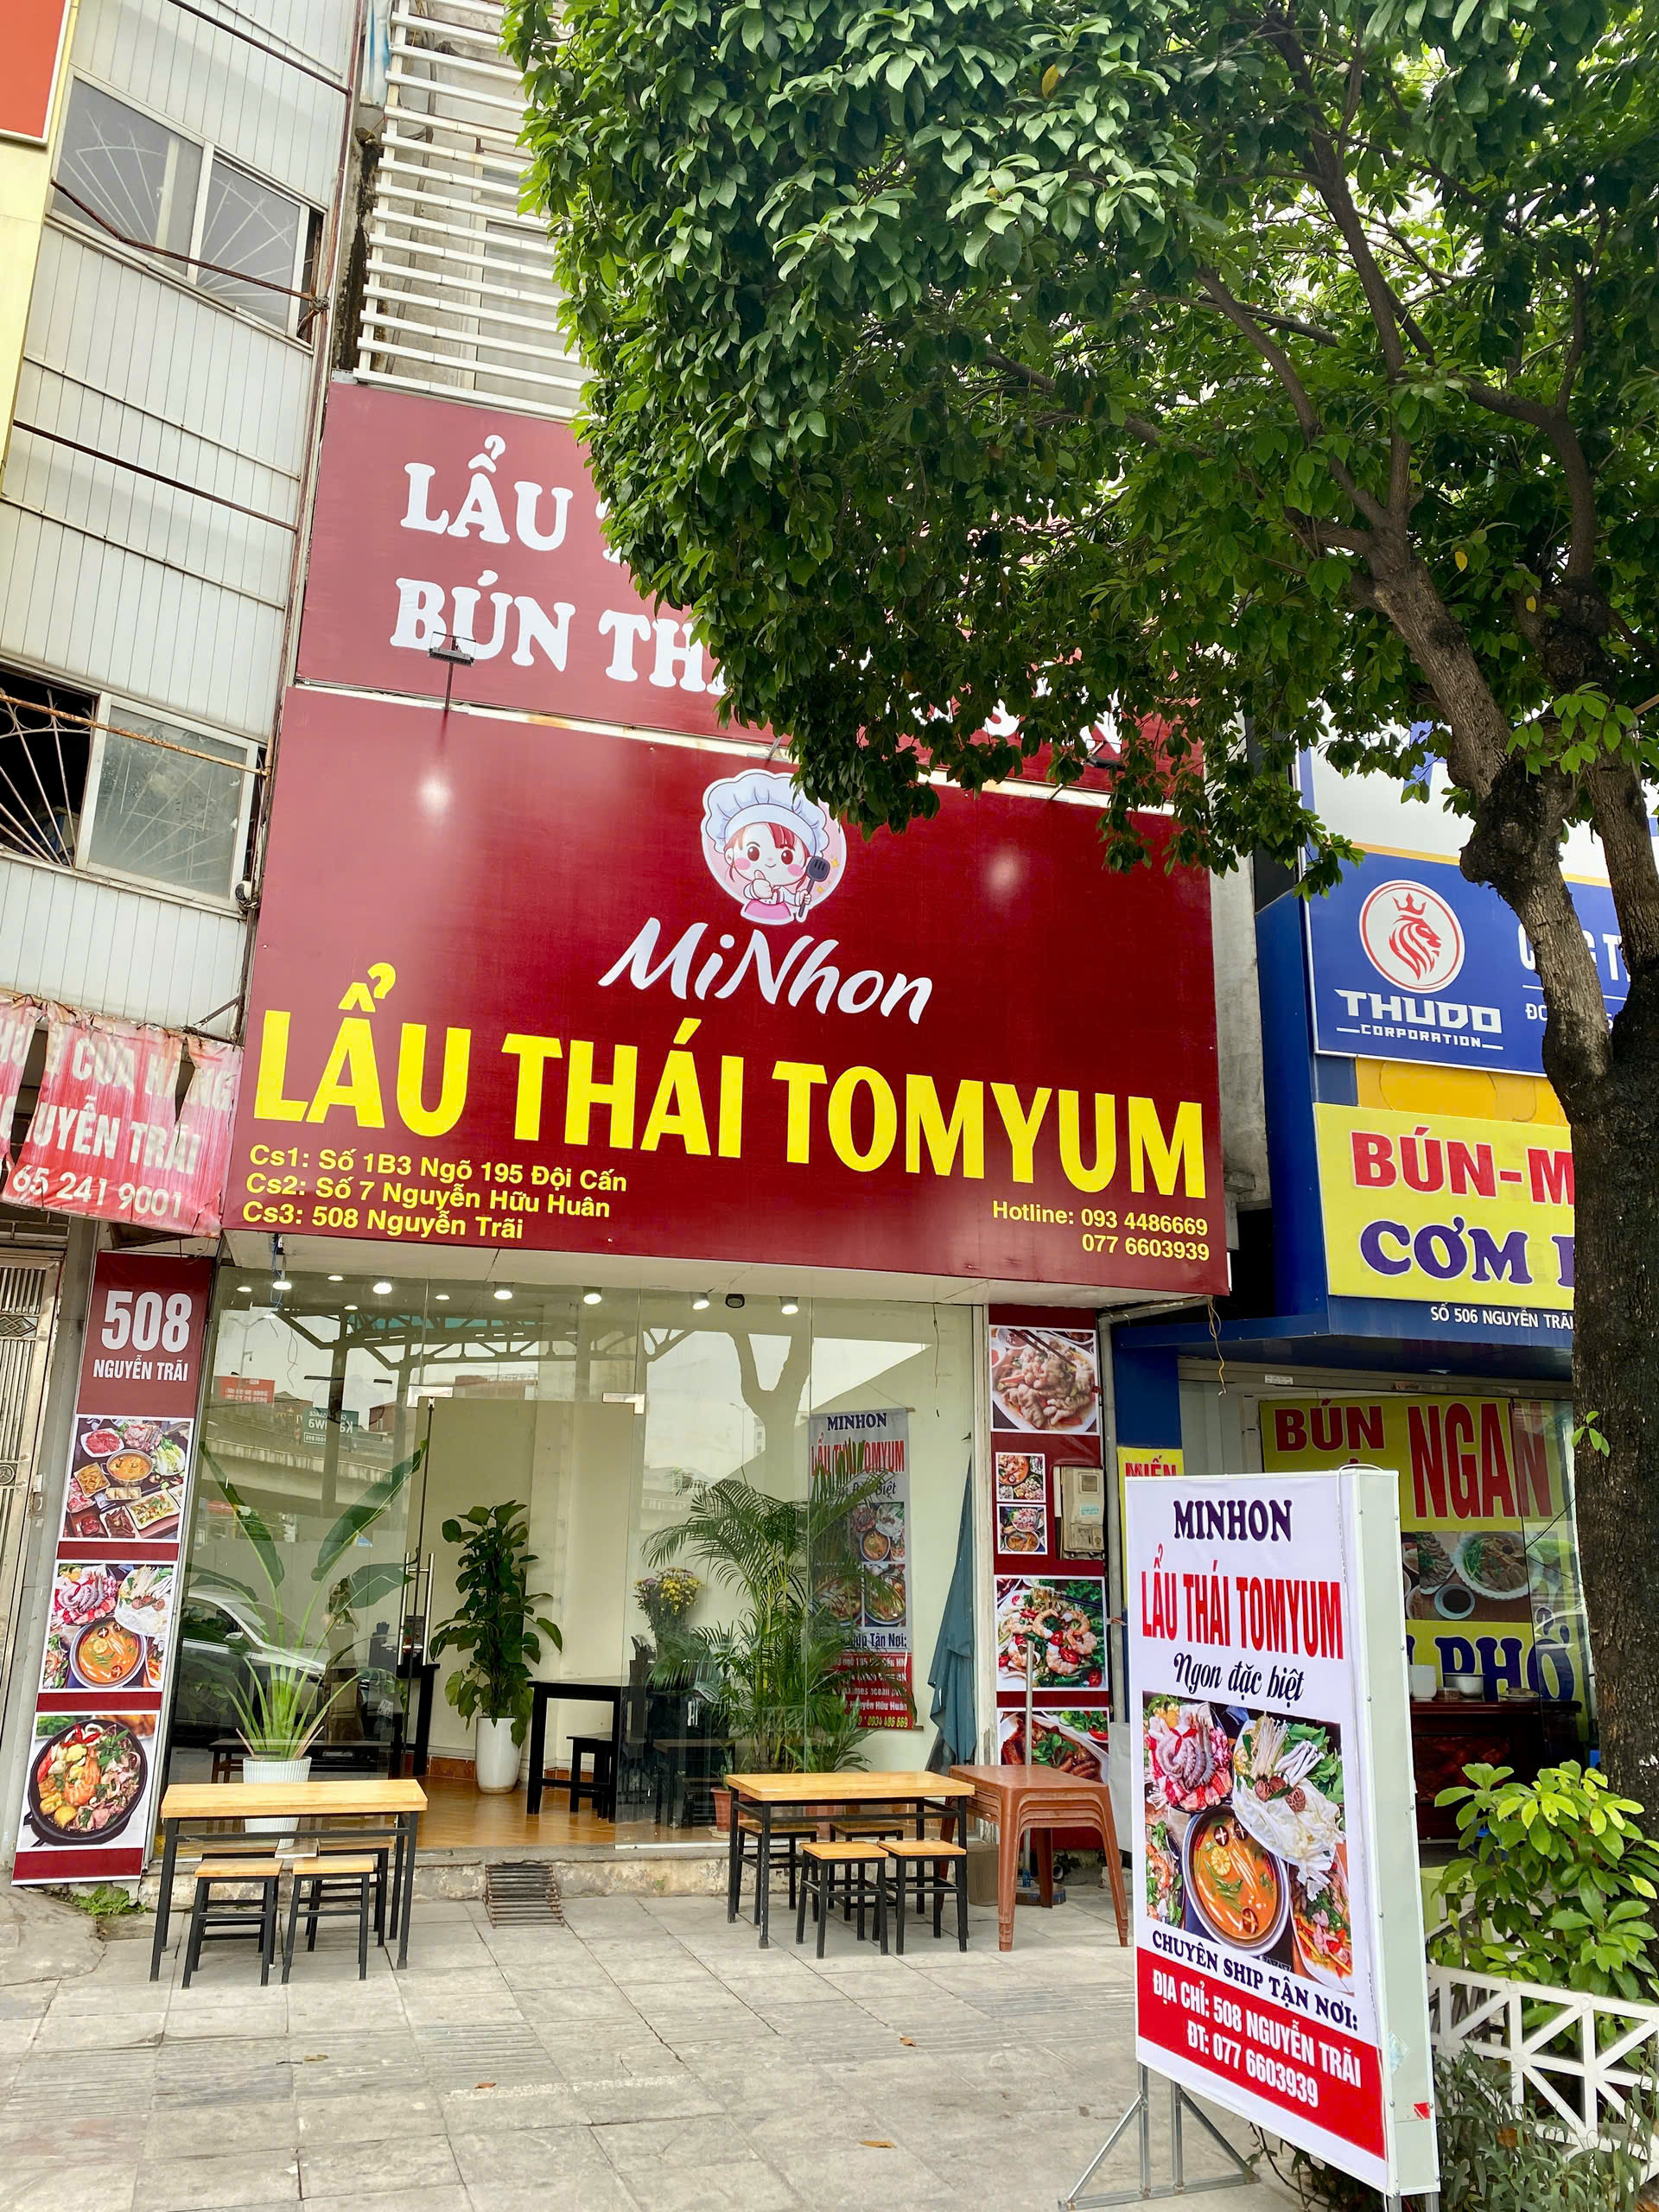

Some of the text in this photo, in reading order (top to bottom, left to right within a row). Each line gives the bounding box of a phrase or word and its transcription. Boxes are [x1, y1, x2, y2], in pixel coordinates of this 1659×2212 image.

[400, 435, 573, 550] LẨU
[390, 569, 728, 696] BÚN TH
[1334, 988, 1502, 1034] THUDO
[1360, 1024, 1481, 1048] CORPORATION
[254, 962, 1206, 1198] LẨU THÁI TOMYUM
[250, 1145, 627, 1192] Cs1: Số 1B3 Ngõ 195 Đội Cấn
[56, 1172, 107, 1205] 241
[118, 1182, 182, 1218] 9001
[246, 1173, 610, 1217] Cs2: Số 7 Nguyễn Hữu Huân
[992, 1200, 1208, 1236] Hotline: 093 4486669
[243, 1201, 524, 1239] Cs3: 508 Nguyễn Trãi
[1082, 1233, 1210, 1262] 077 6603939
[1360, 1216, 1533, 1285] CƠM
[101, 1289, 194, 1353] 508
[1431, 1302, 1573, 1330] SỐ 506 NGUYỄN TRÃI
[92, 1354, 188, 1382] NGUYỄN TRÃI
[827, 1413, 887, 1431] MINHON
[1274, 1398, 1553, 1519] BÚN NGAN
[1173, 1499, 1292, 1542] MINHON
[1141, 1543, 1344, 1660] LẨU THÁI TOMYUM
[1173, 1652, 1305, 1708] Ngon đặc biệt
[1153, 1930, 1358, 2031] CHUYÊN SHIP TẬN NƠI:
[1153, 1968, 1361, 2088] ĐỊA CHỈ: 508 NGUYỄN TRÃI
[1187, 2020, 1319, 2108] ĐT: 077 6603939
